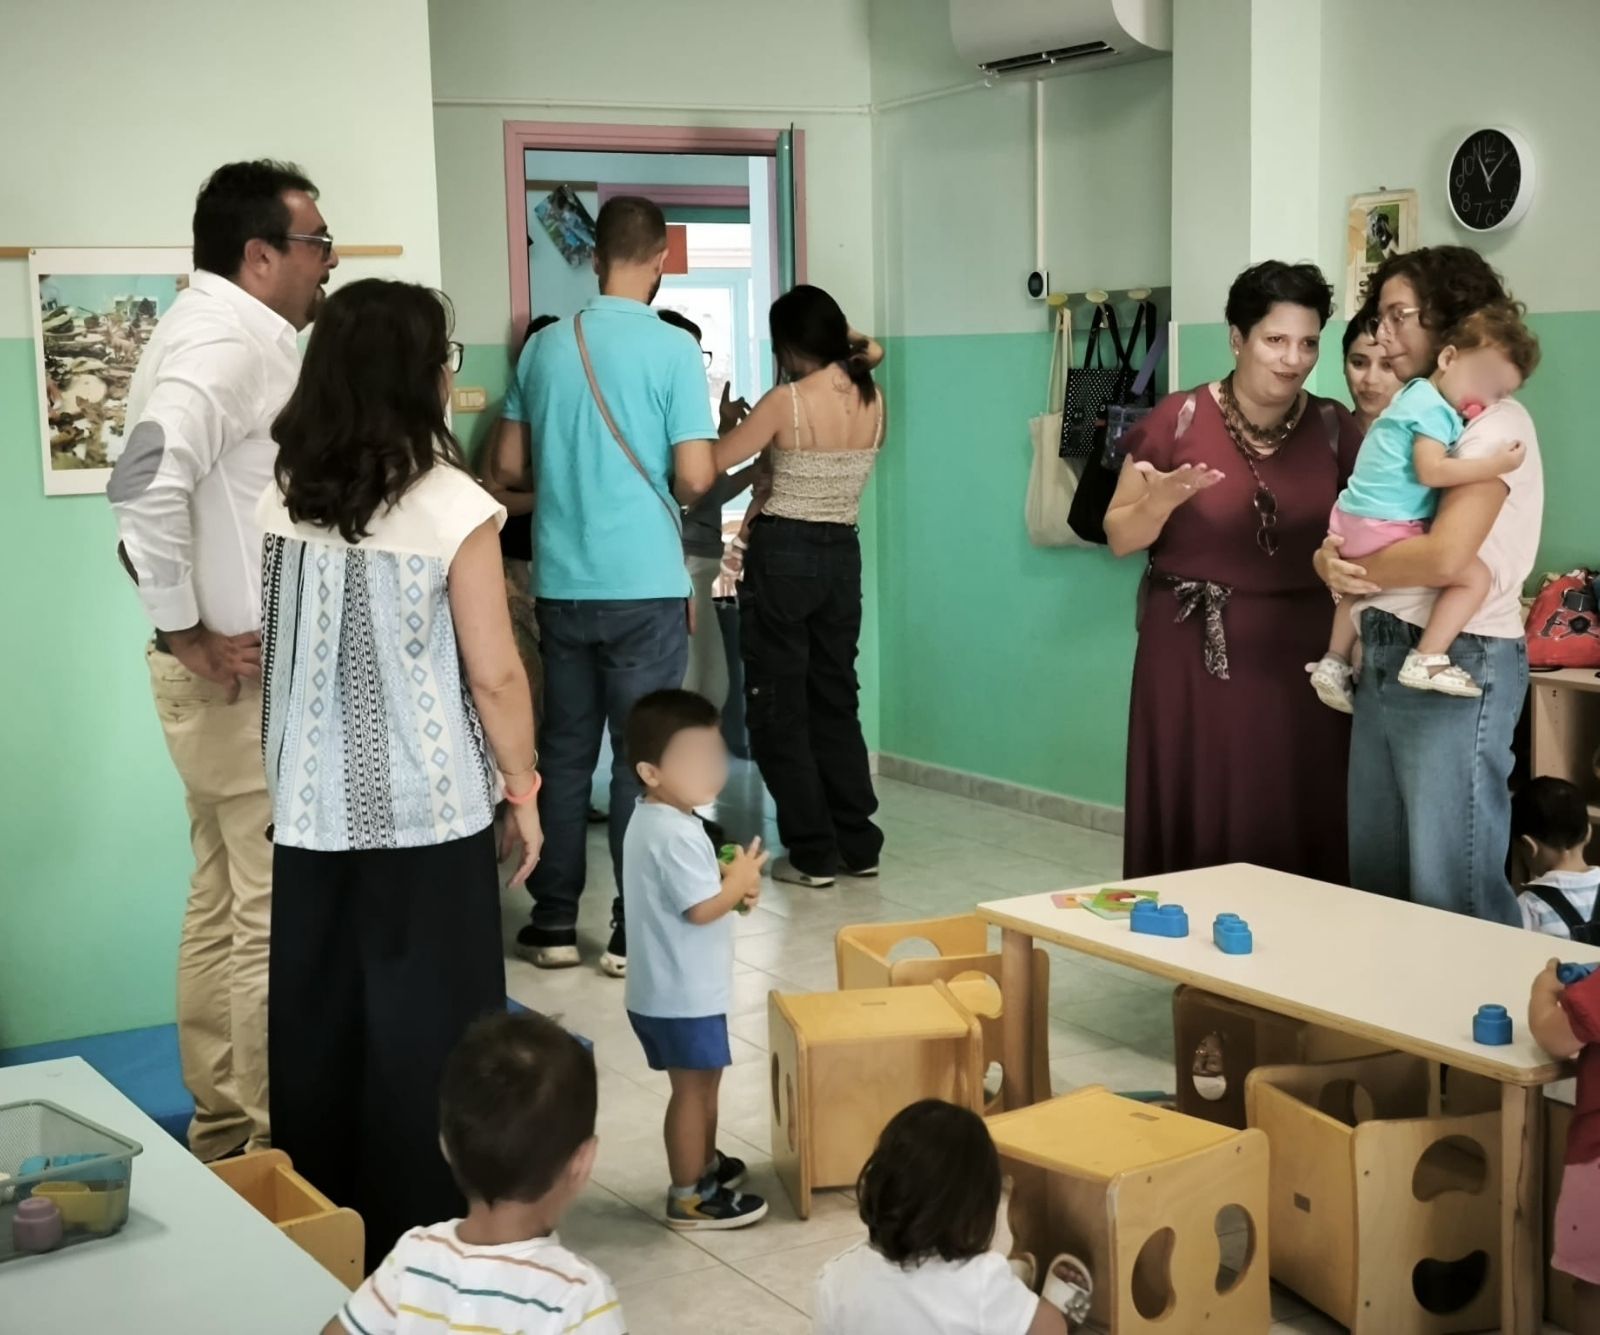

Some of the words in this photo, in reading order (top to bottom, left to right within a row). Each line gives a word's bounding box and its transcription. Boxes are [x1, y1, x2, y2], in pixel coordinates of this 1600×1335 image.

[1484, 133, 1496, 155] 12
[1461, 192, 1471, 212] 8
[1500, 198, 1510, 218] 5
[1472, 202, 1482, 223] 7
[1485, 207, 1495, 227] 6
